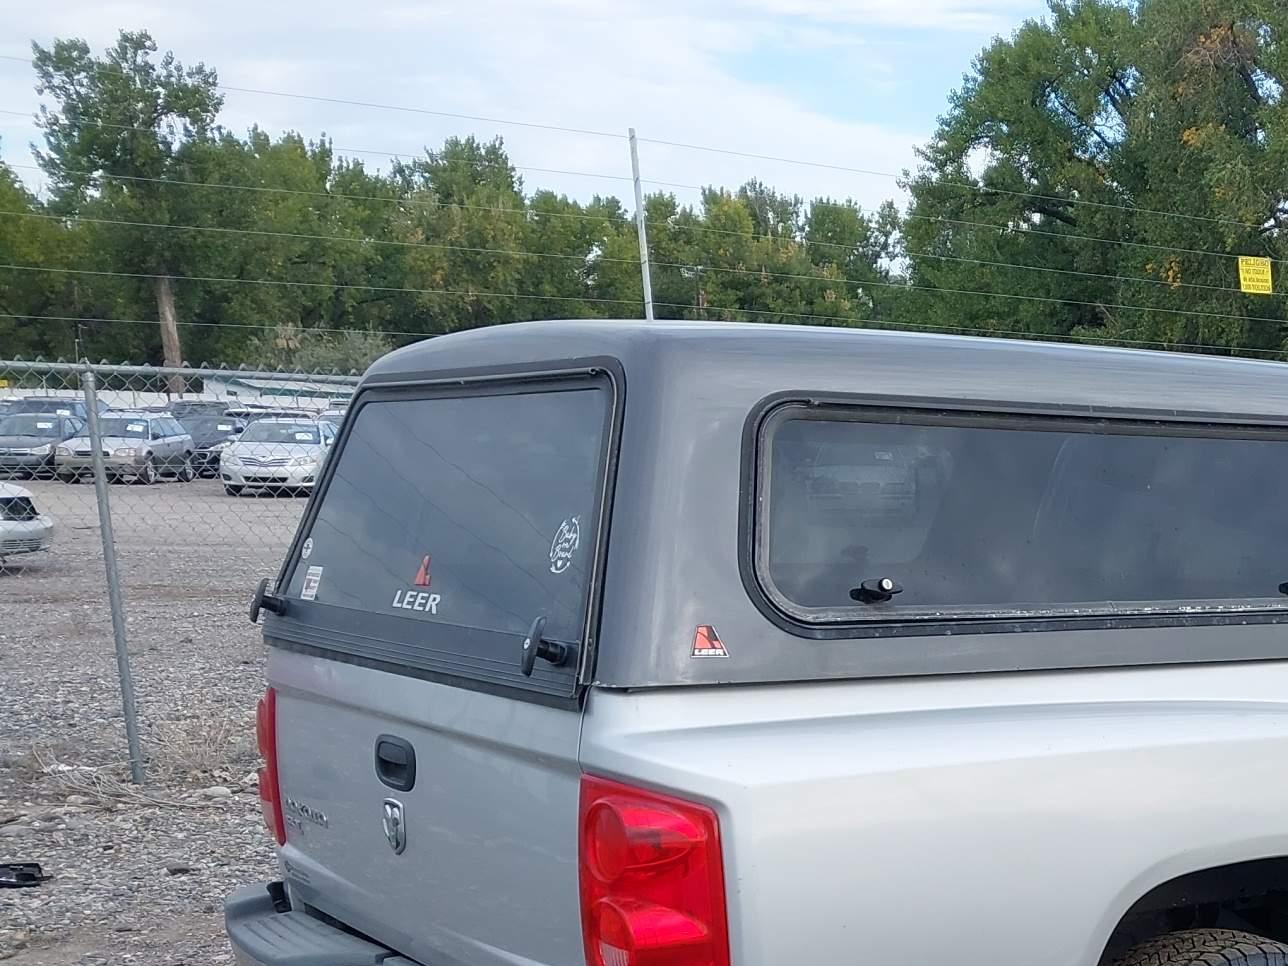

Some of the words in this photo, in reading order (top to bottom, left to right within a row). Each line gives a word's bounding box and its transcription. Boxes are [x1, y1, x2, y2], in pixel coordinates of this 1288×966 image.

[558, 525, 577, 545] Baby
[392, 589, 441, 615] LEER
[694, 648, 724, 656] LEER
